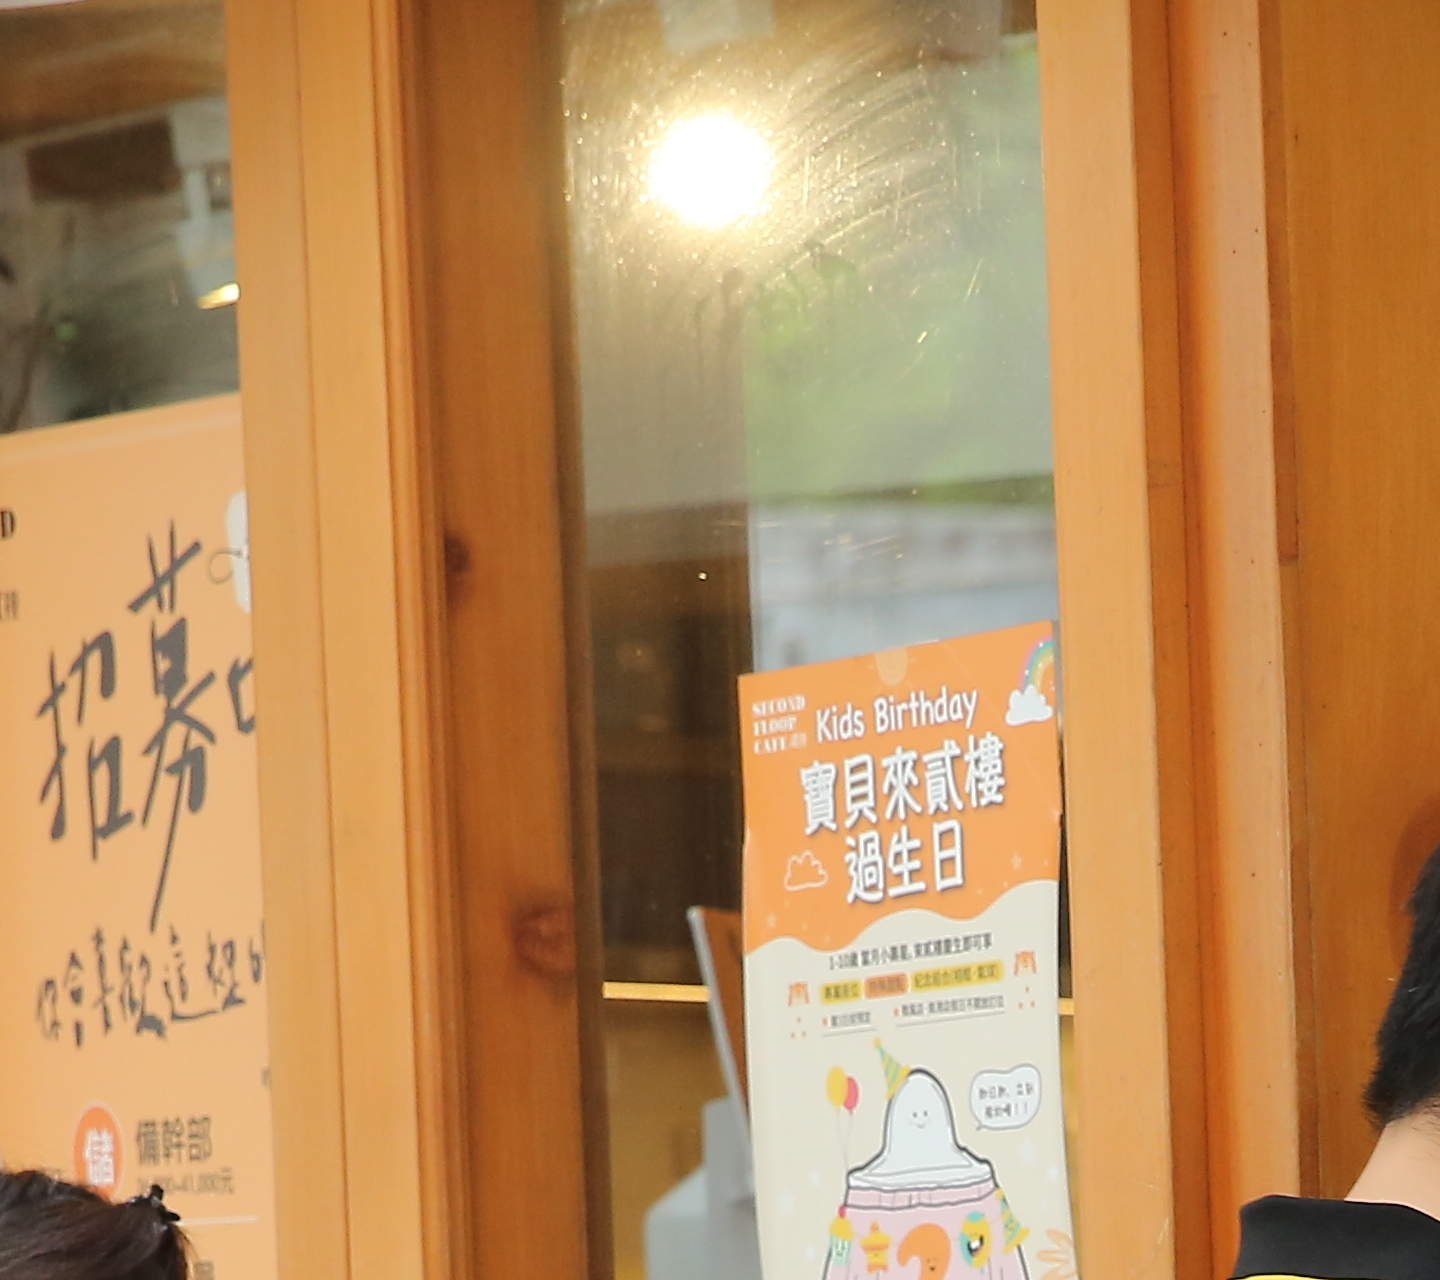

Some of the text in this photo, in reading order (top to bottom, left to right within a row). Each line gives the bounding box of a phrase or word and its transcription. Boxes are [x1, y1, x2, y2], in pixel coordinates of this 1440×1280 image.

[815, 686, 978, 743] Kids Birthday
[799, 730, 1007, 836] 寶貝來貳樓
[844, 819, 964, 906] 過生日
